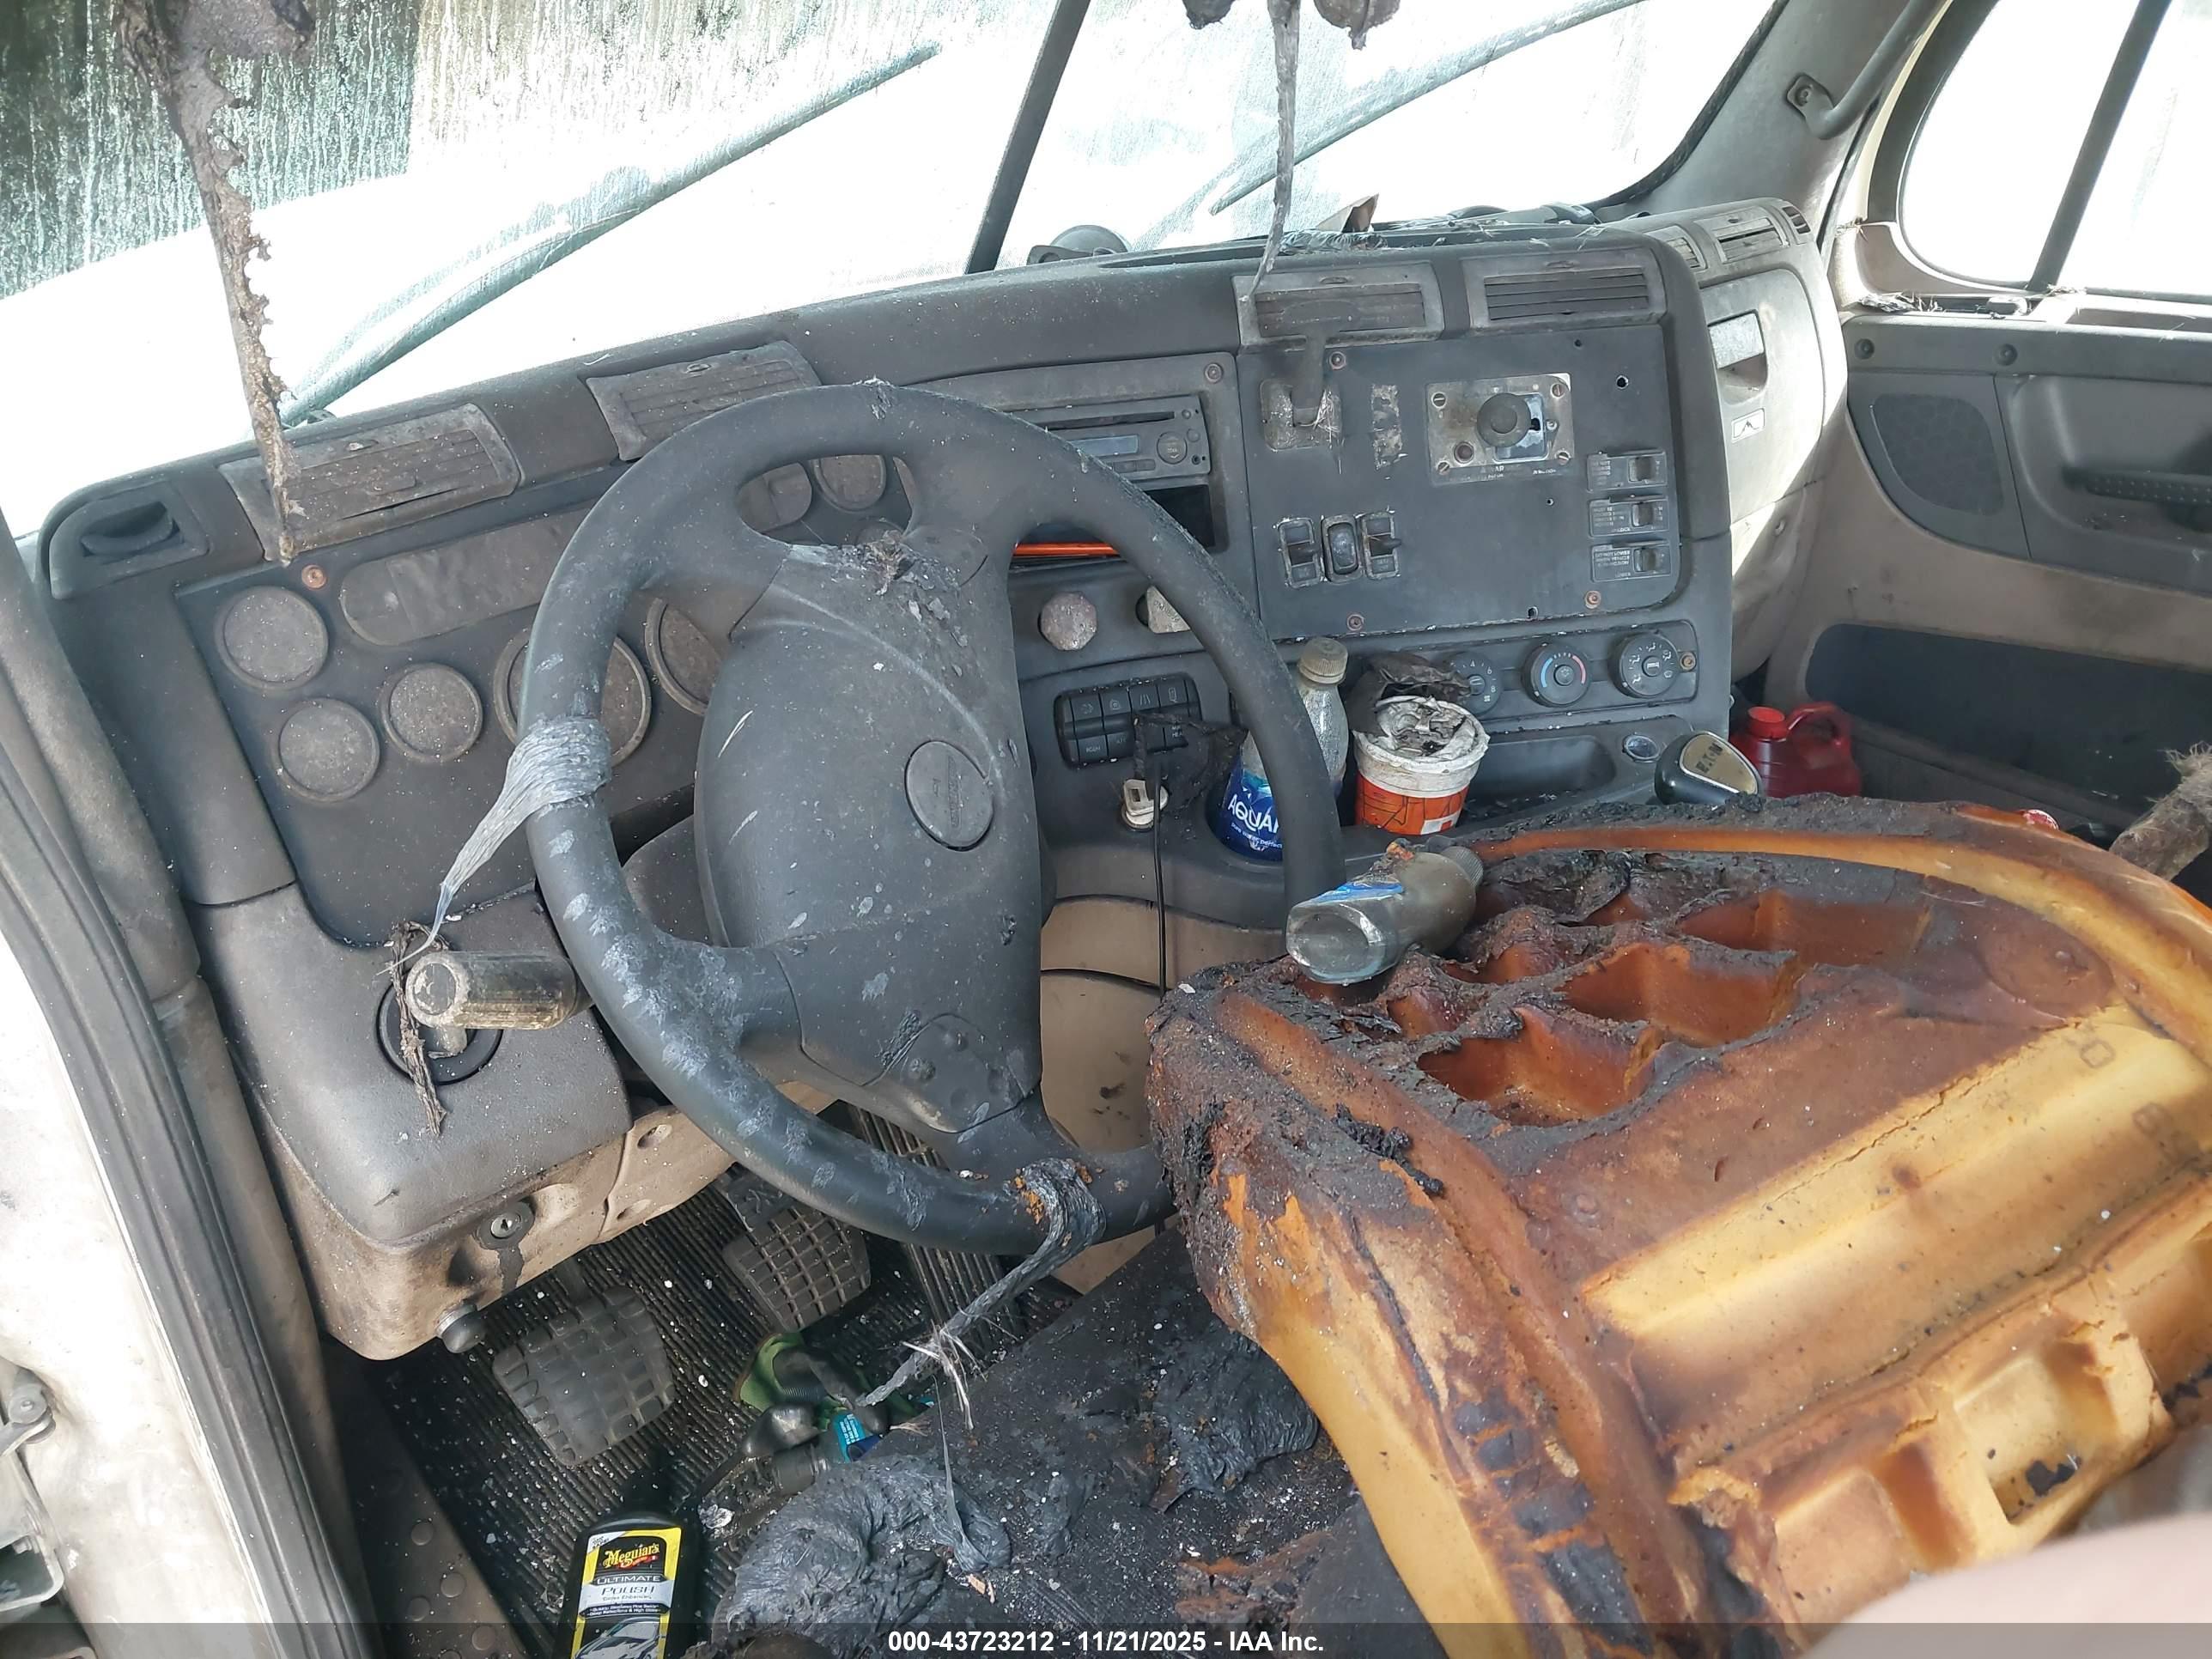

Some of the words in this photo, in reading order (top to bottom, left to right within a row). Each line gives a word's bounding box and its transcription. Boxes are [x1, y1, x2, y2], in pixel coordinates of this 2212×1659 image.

[1486, 665, 1493, 675] 6
[602, 1542, 660, 1570] Meguiar's
[597, 1575, 661, 1585] ULTIMATE
